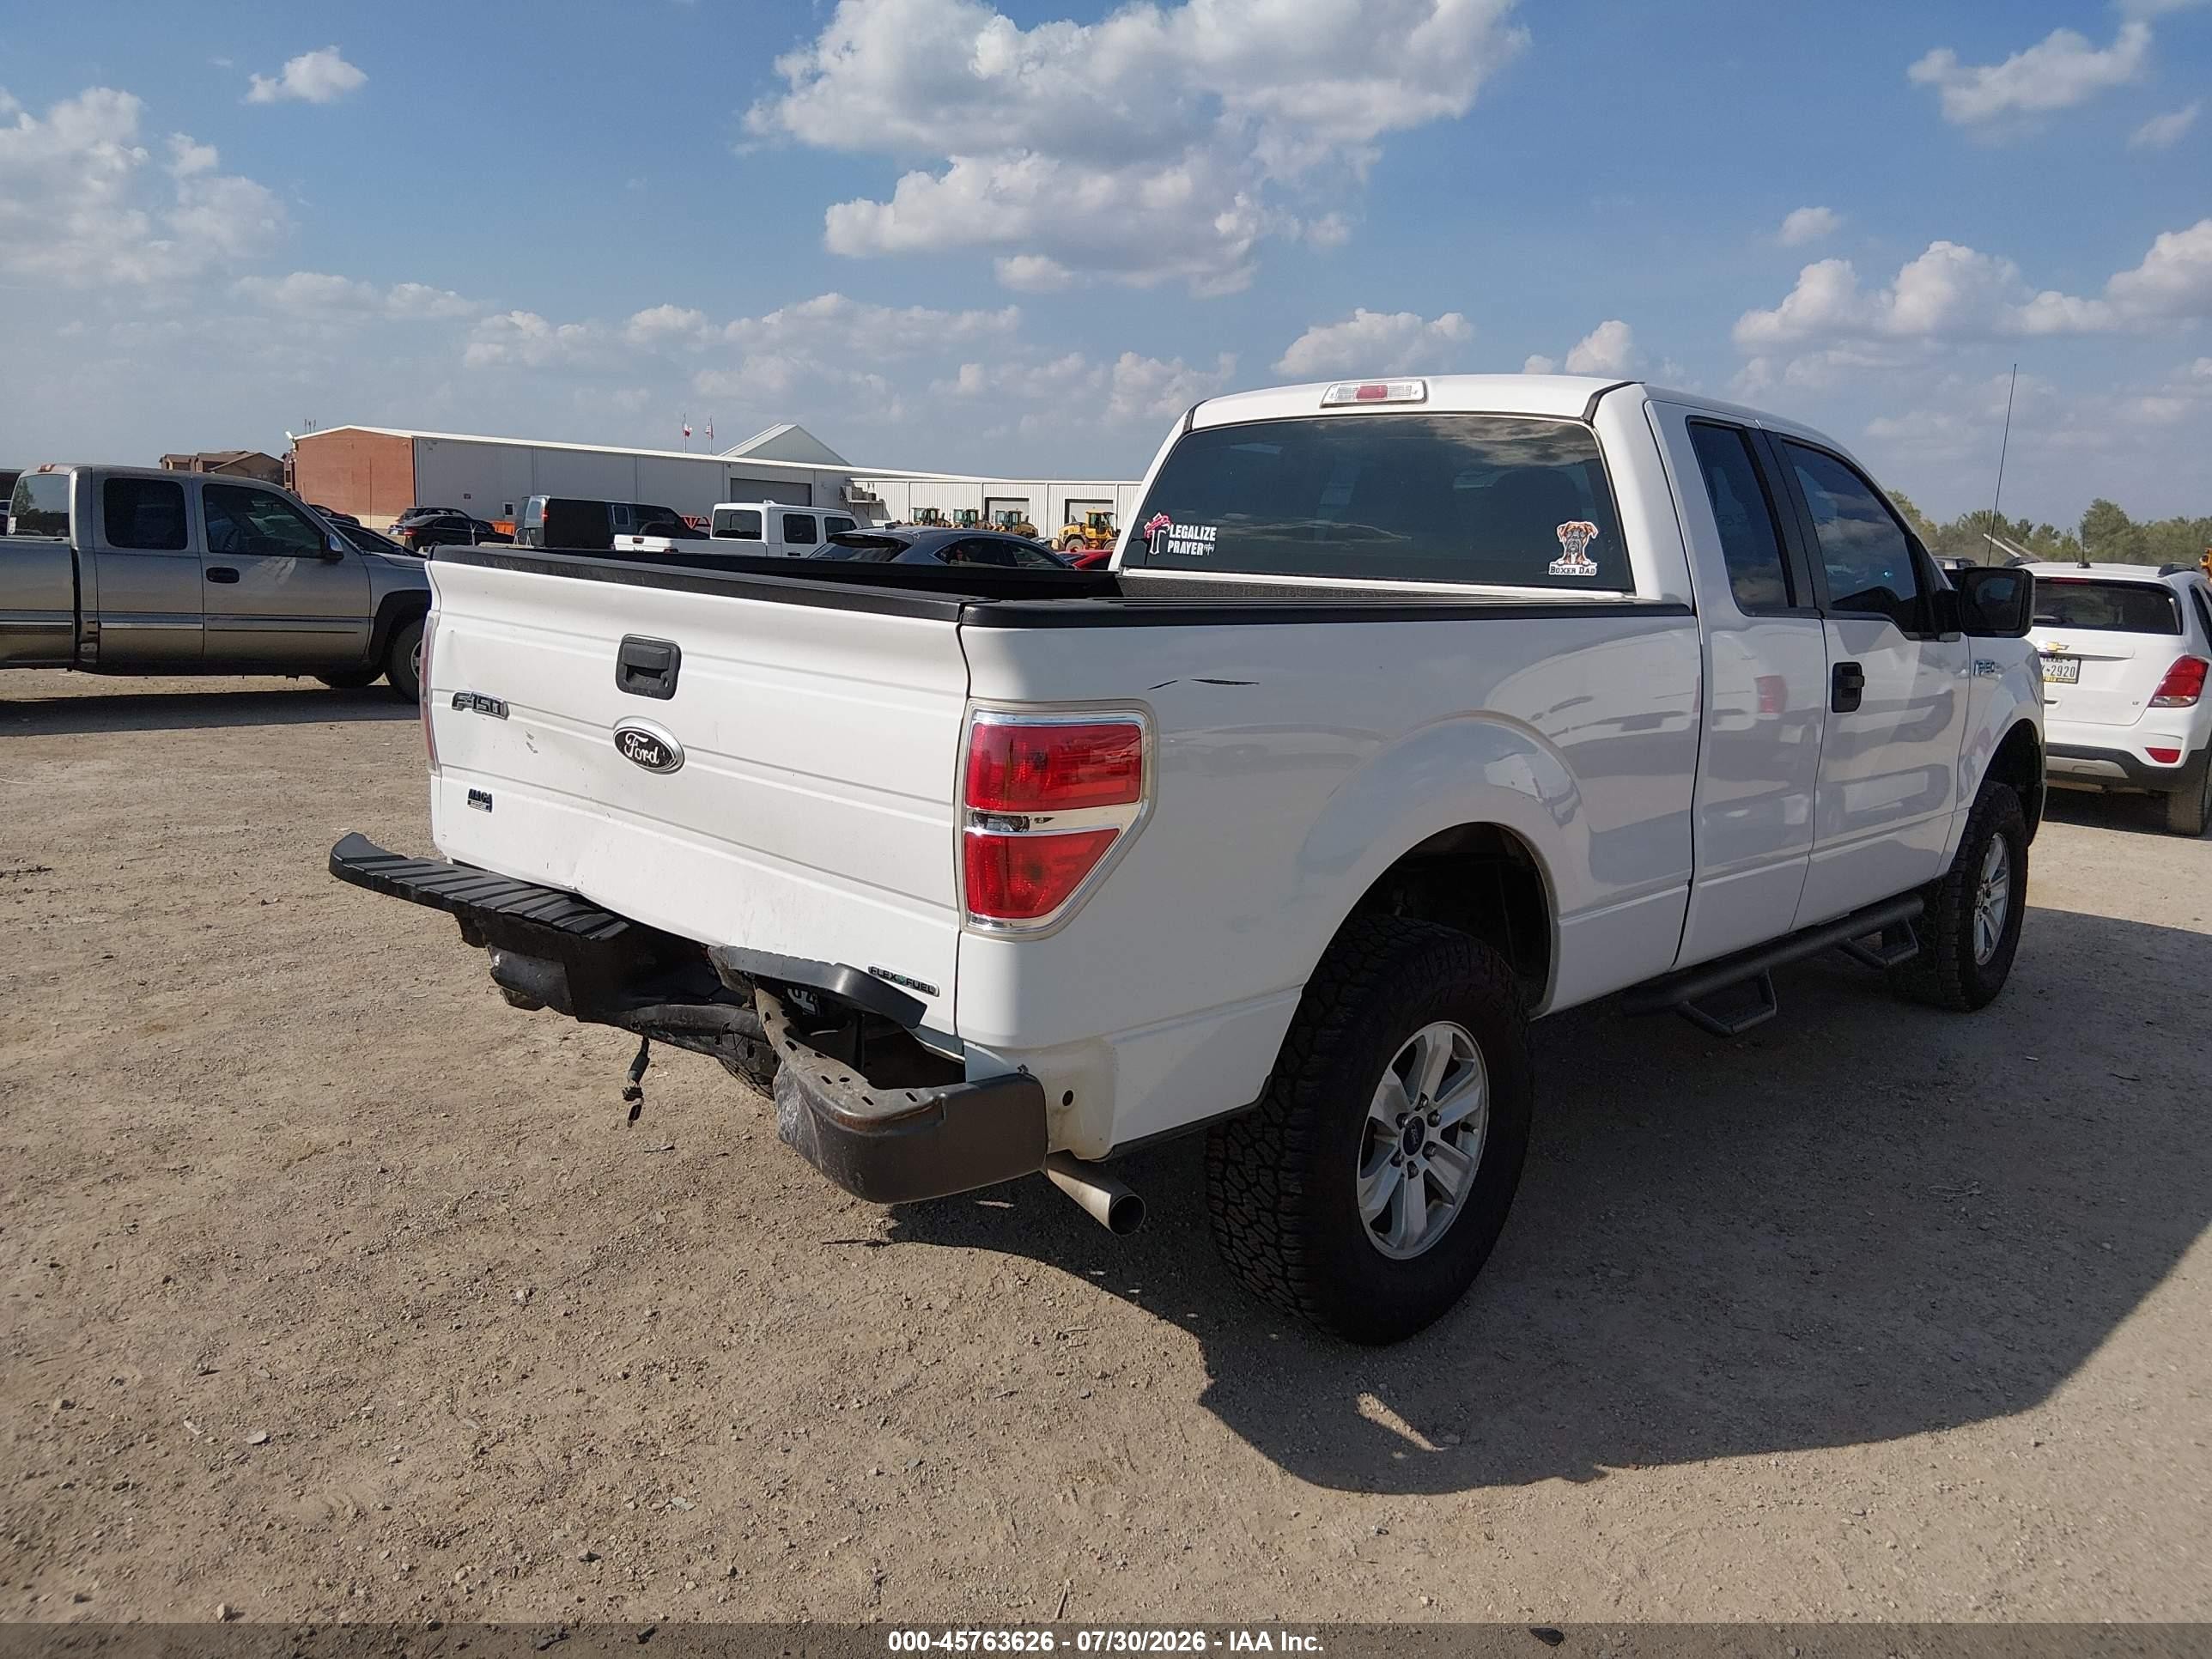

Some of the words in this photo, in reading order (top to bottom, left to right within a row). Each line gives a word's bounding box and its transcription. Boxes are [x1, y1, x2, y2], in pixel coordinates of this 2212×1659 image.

[1170, 525, 1217, 541] LEGALIZE
[1168, 540, 1204, 556] PRAYER
[624, 732, 659, 764] Ford
[870, 966, 897, 981] FLEX
[906, 978, 936, 995] FUEL
